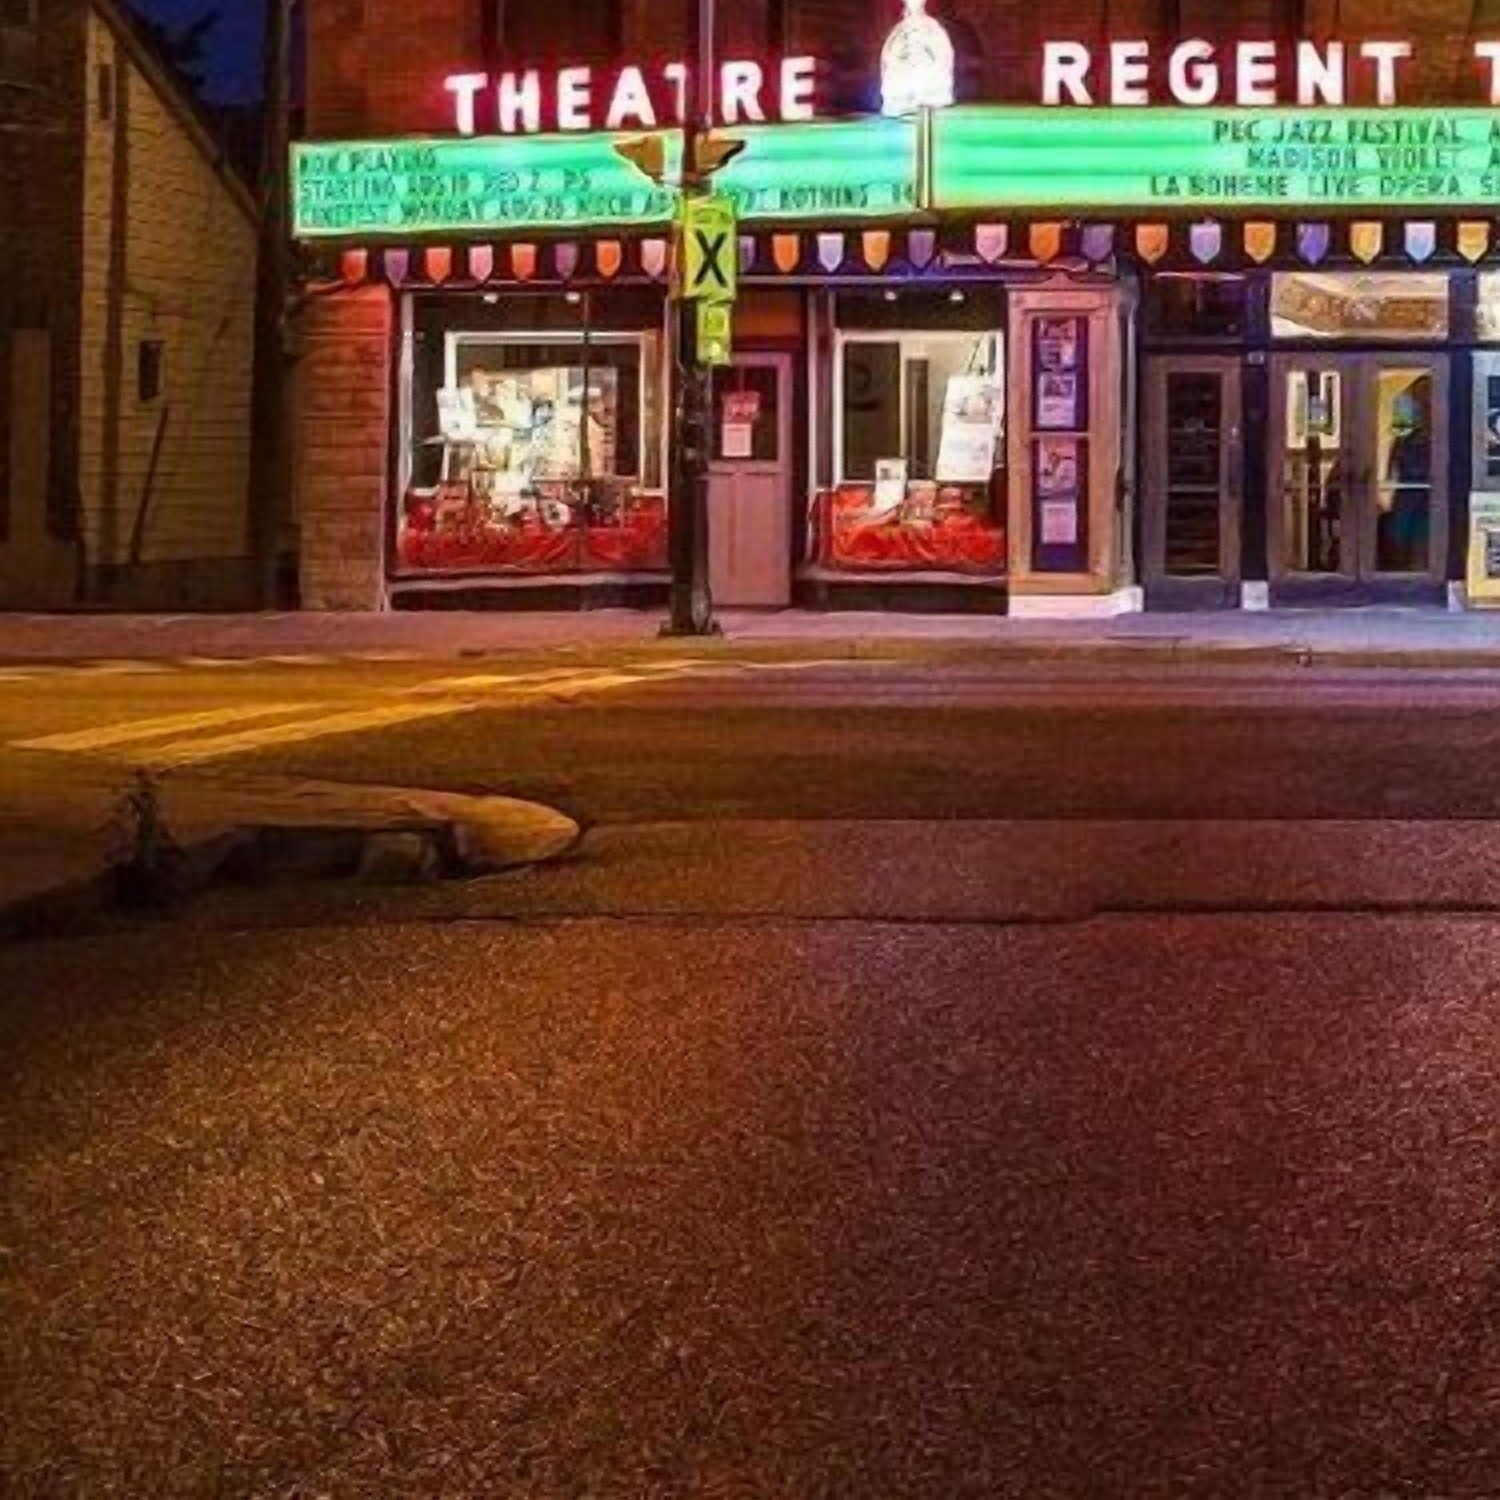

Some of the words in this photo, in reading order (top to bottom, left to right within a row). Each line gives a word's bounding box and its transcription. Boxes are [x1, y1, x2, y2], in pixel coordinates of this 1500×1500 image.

[1041, 40, 1412, 106] REGENT
[443, 56, 817, 136] THEATRE
[1214, 120, 1261, 143] PEC
[1271, 120, 1333, 143] JAZZ
[1347, 120, 1466, 144] FESTIVAL
[1247, 147, 1356, 169] MADISON
[1376, 147, 1457, 169] VIOLET
[1307, 175, 1361, 196] LIVE
[1380, 175, 1461, 196] OPERA
